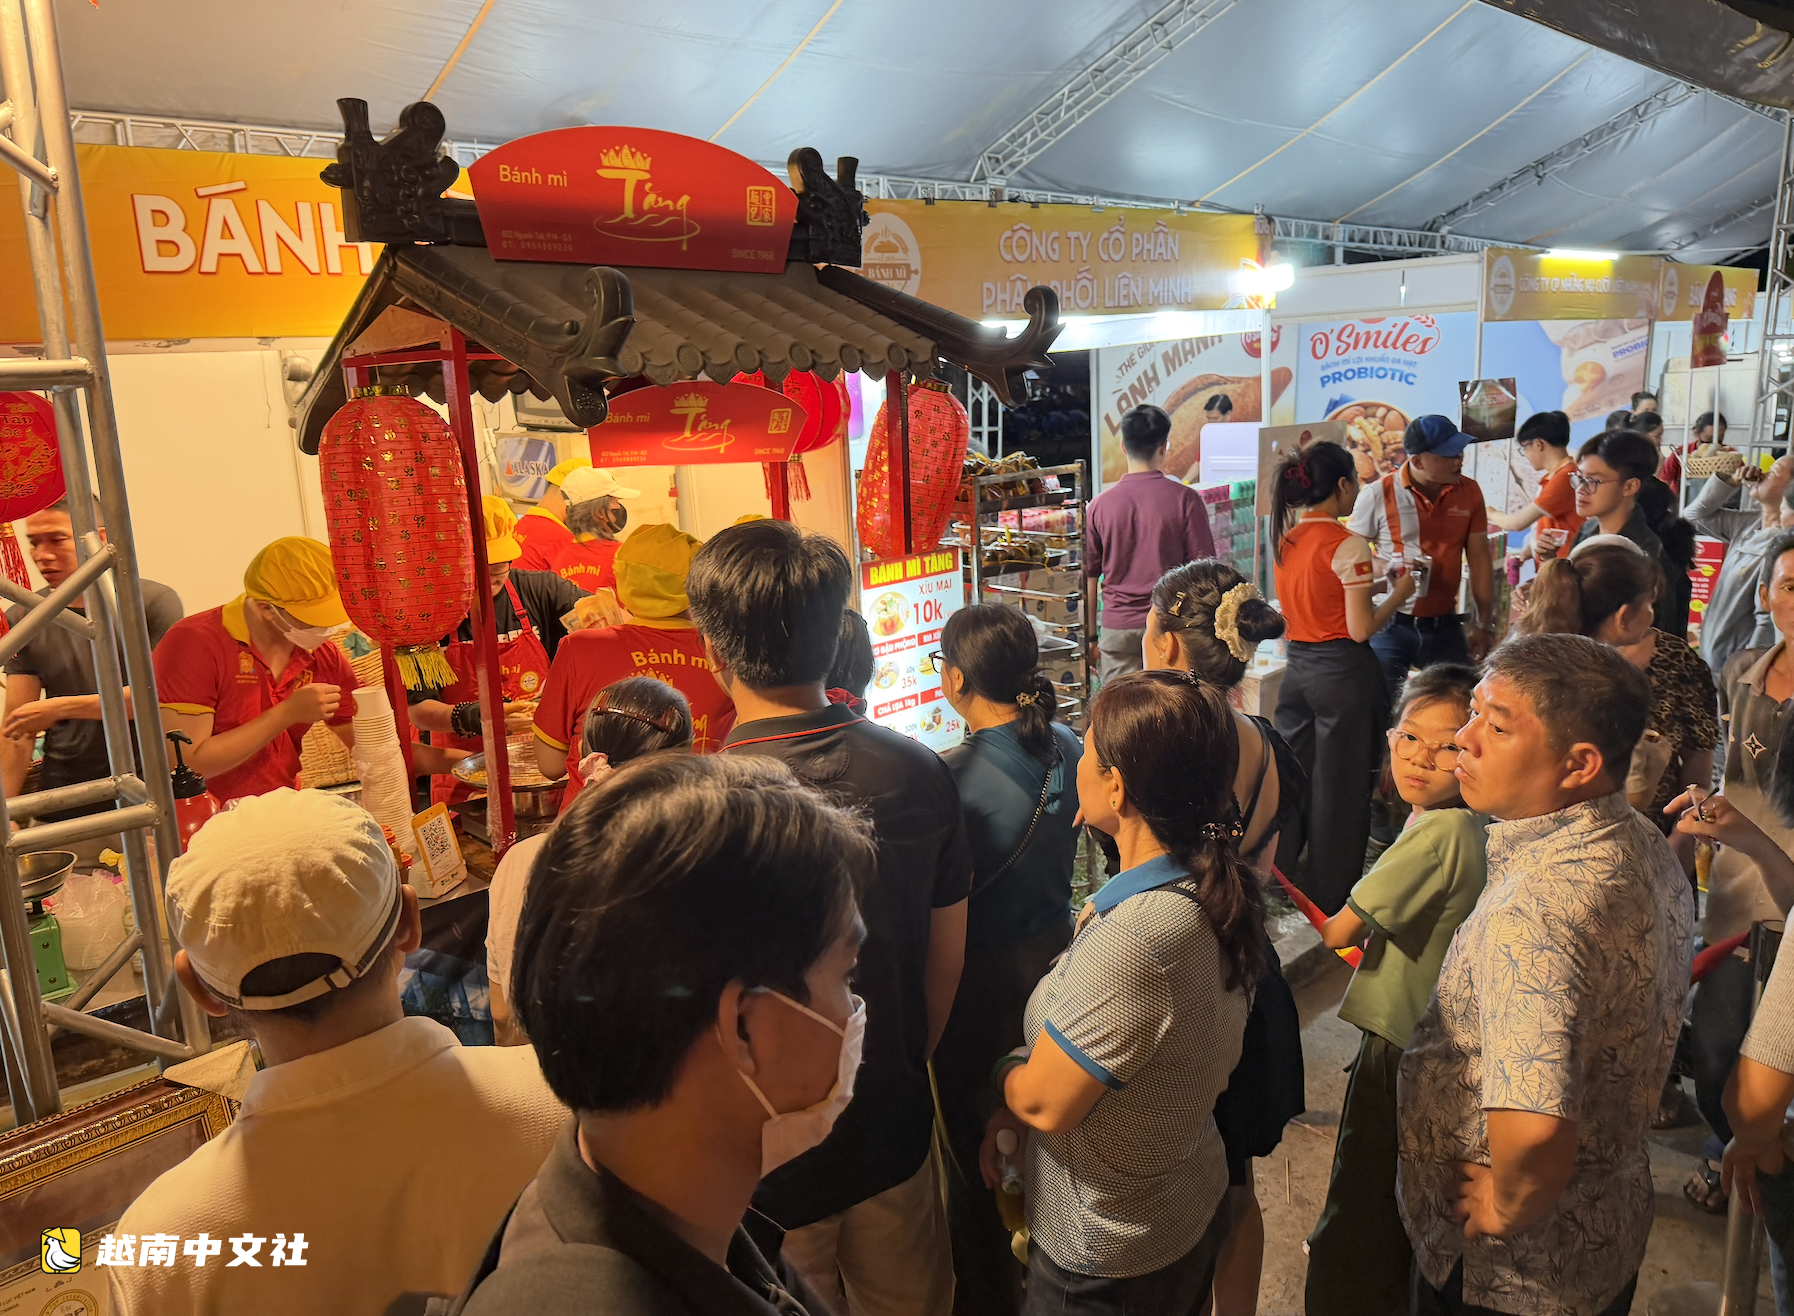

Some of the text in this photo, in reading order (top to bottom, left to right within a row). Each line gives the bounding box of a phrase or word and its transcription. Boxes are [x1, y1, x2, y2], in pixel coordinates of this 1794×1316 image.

[500, 164, 568, 187] Bánh mì
[596, 168, 691, 250] Tăng
[131, 180, 374, 276] BÁNH
[1000, 215, 1179, 262] CÔNG TY CỔ PHẦN
[732, 249, 755, 259] SINCE
[868, 265, 907, 279] BÁNH MÌ
[982, 273, 1038, 314] PHÂ
[1104, 271, 1142, 308] LIÊN
[1149, 276, 1192, 306] MINH
[1310, 321, 1437, 360] O'Smiles
[1320, 366, 1418, 388] PROBIOTIC
[606, 412, 633, 424] Bánh
[670, 407, 731, 453] Tăng
[511, 459, 550, 477] ALASKA
[560, 563, 585, 578] Bánh
[870, 552, 953, 586] BÁNH MÌ TĂNG
[919, 578, 952, 595] XÍU MẠI
[913, 598, 943, 625] 10k
[631, 649, 710, 670] Bánh m
[902, 675, 917, 689] 35k
[946, 719, 961, 733] 25k
